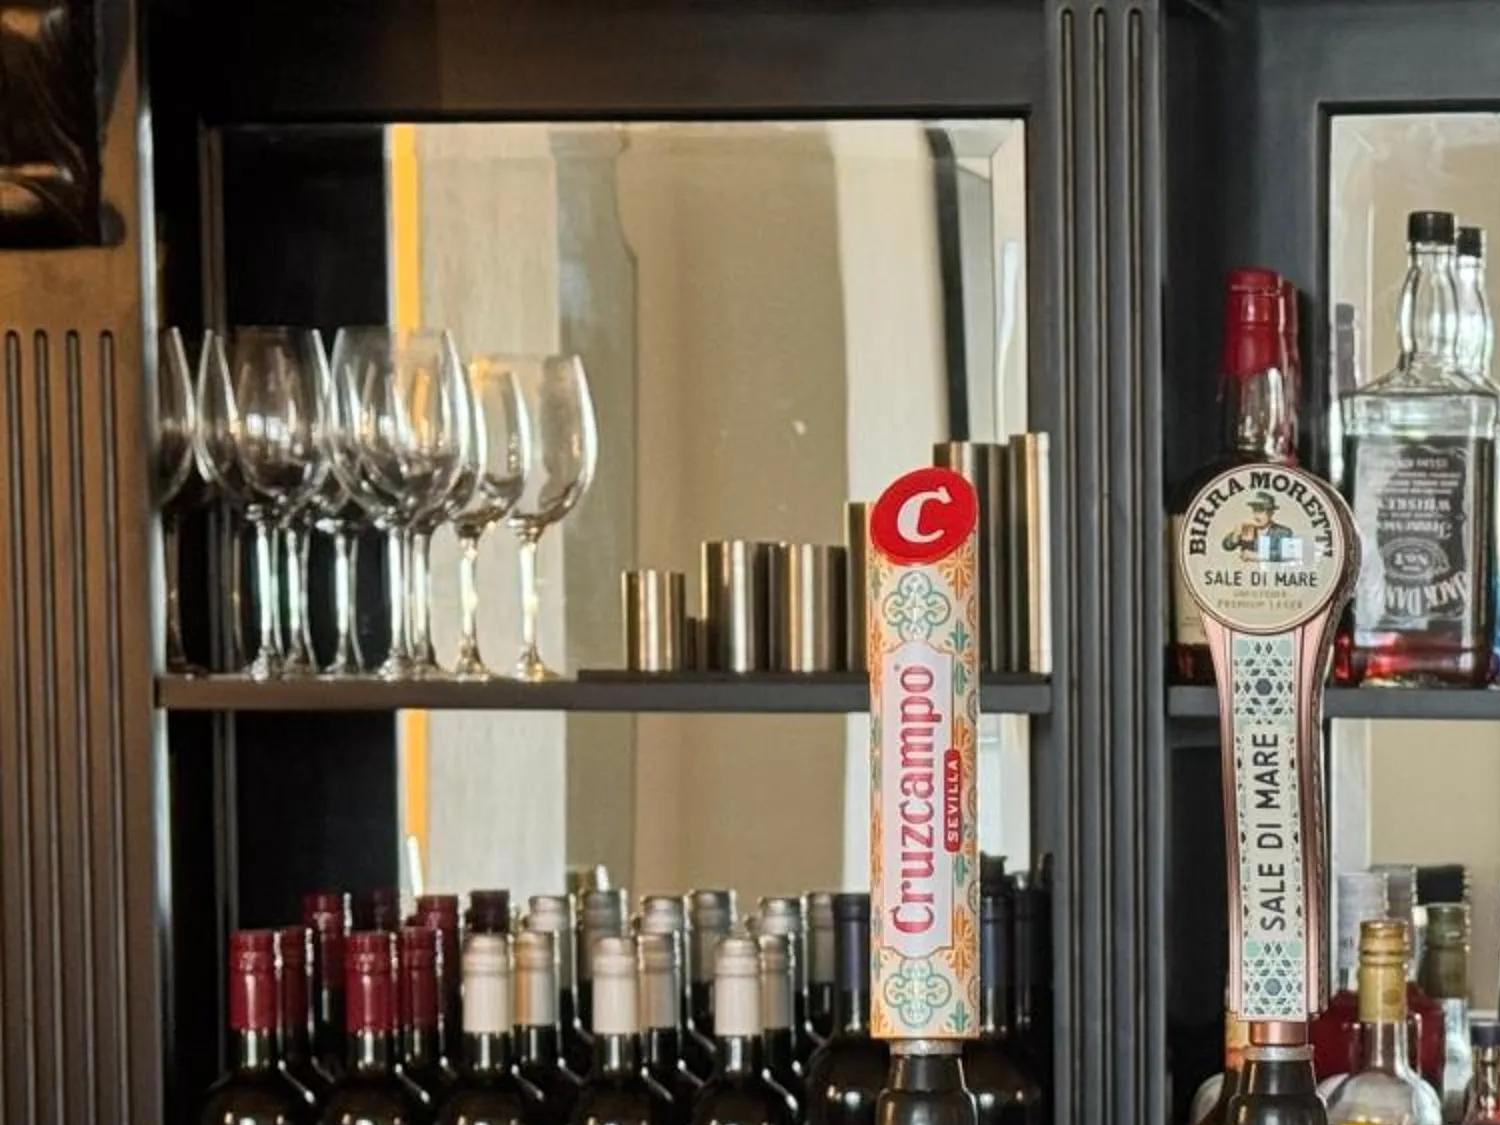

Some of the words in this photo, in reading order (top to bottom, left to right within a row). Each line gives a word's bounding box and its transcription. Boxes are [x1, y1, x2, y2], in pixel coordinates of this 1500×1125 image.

[1189, 476, 1245, 556] BIRRA
[1204, 569, 1243, 586] SALE
[1250, 572, 1267, 587] DI
[1274, 571, 1319, 588] MARE
[889, 664, 943, 935] Cruzcampo
[946, 760, 960, 843] SEVILLA
[1252, 733, 1282, 810] MARE
[1256, 823, 1284, 849] DI
[1257, 863, 1287, 932] SALE
